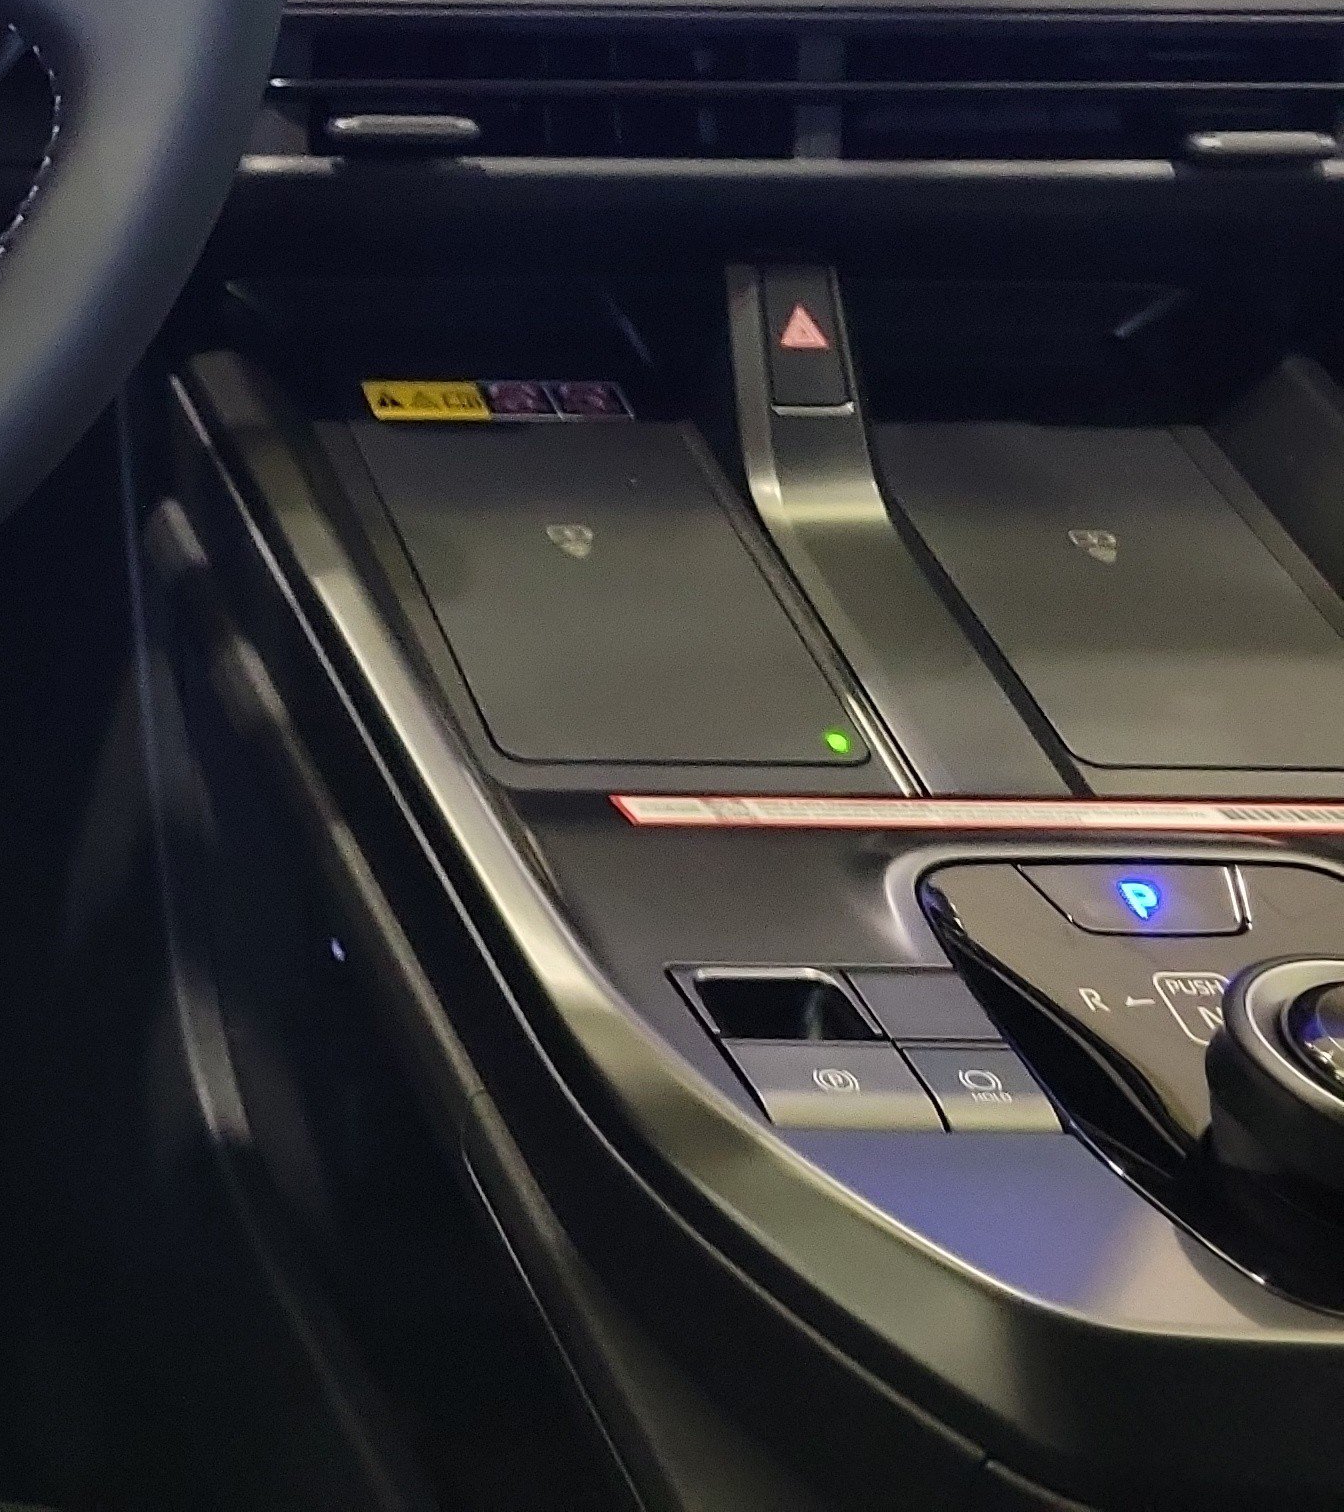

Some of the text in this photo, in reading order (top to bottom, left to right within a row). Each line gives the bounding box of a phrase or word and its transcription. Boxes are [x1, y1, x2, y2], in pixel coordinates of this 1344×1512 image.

[1116, 879, 1160, 920] P
[1164, 979, 1226, 996] PUSH
[1078, 987, 1110, 1012] R
[971, 1091, 1012, 1103] HOLD
